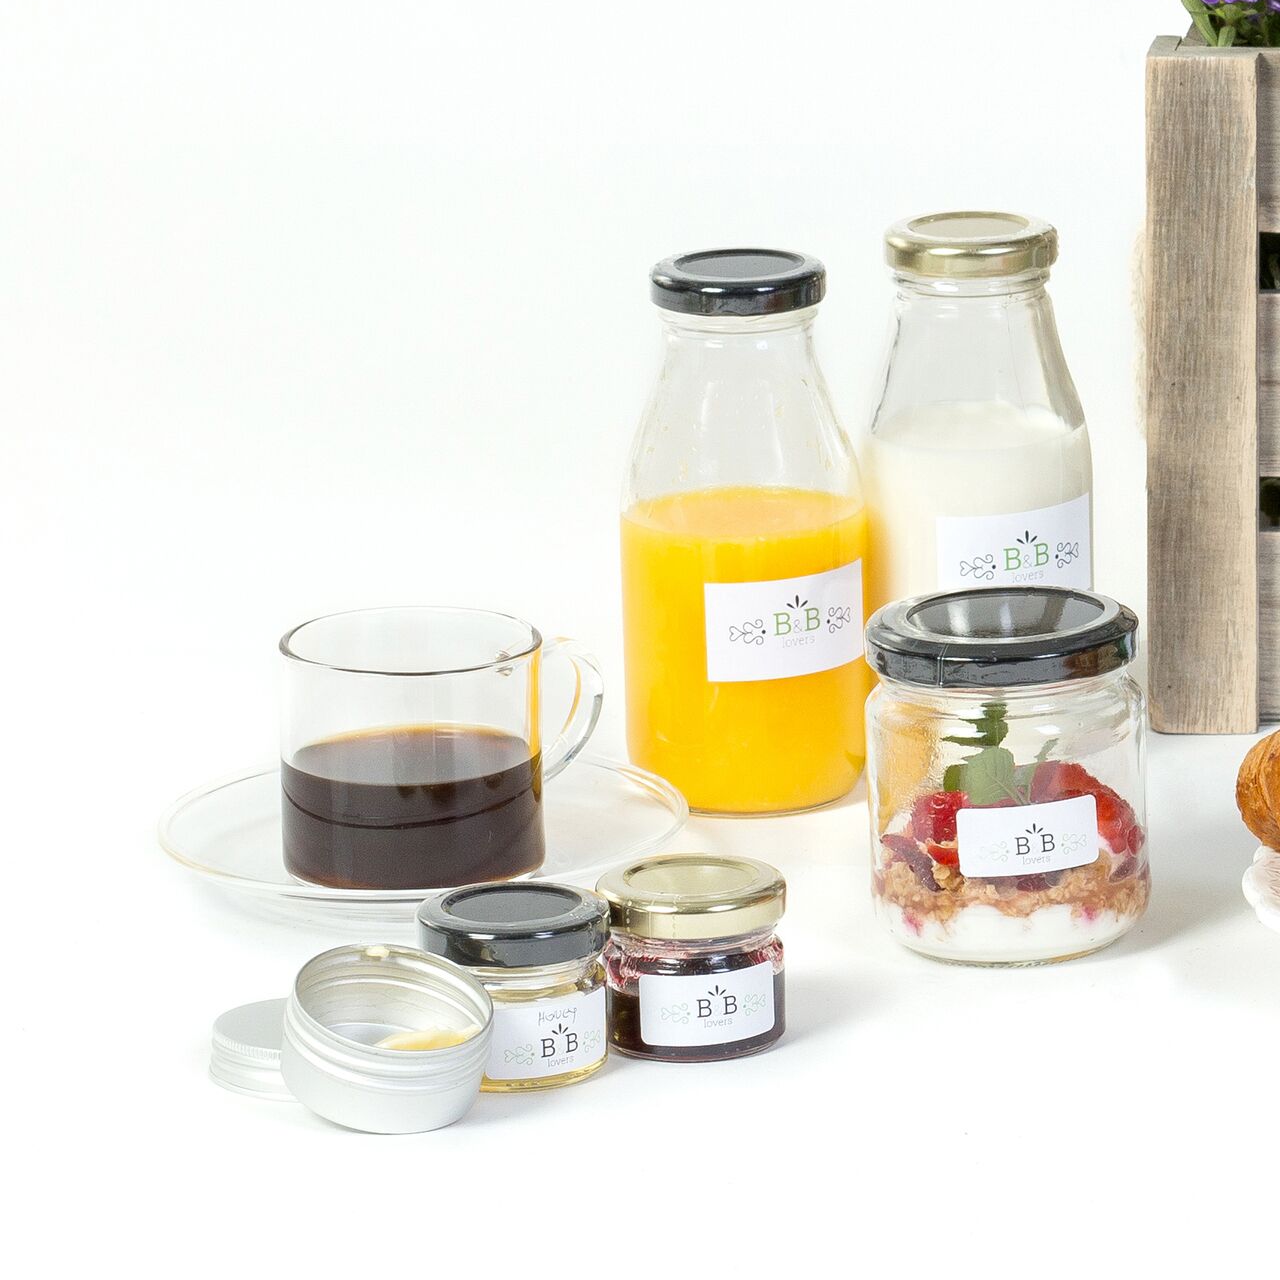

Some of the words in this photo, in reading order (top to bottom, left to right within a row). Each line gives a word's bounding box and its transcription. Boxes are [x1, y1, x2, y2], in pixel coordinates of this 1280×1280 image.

[1003, 542, 1050, 571] B&B
[1012, 569, 1045, 583] lovers
[773, 607, 821, 636] B&B
[782, 634, 815, 649] lovers
[1022, 854, 1051, 866] lovers
[703, 1017, 733, 1029] lovers
[547, 1055, 575, 1068] lovers
